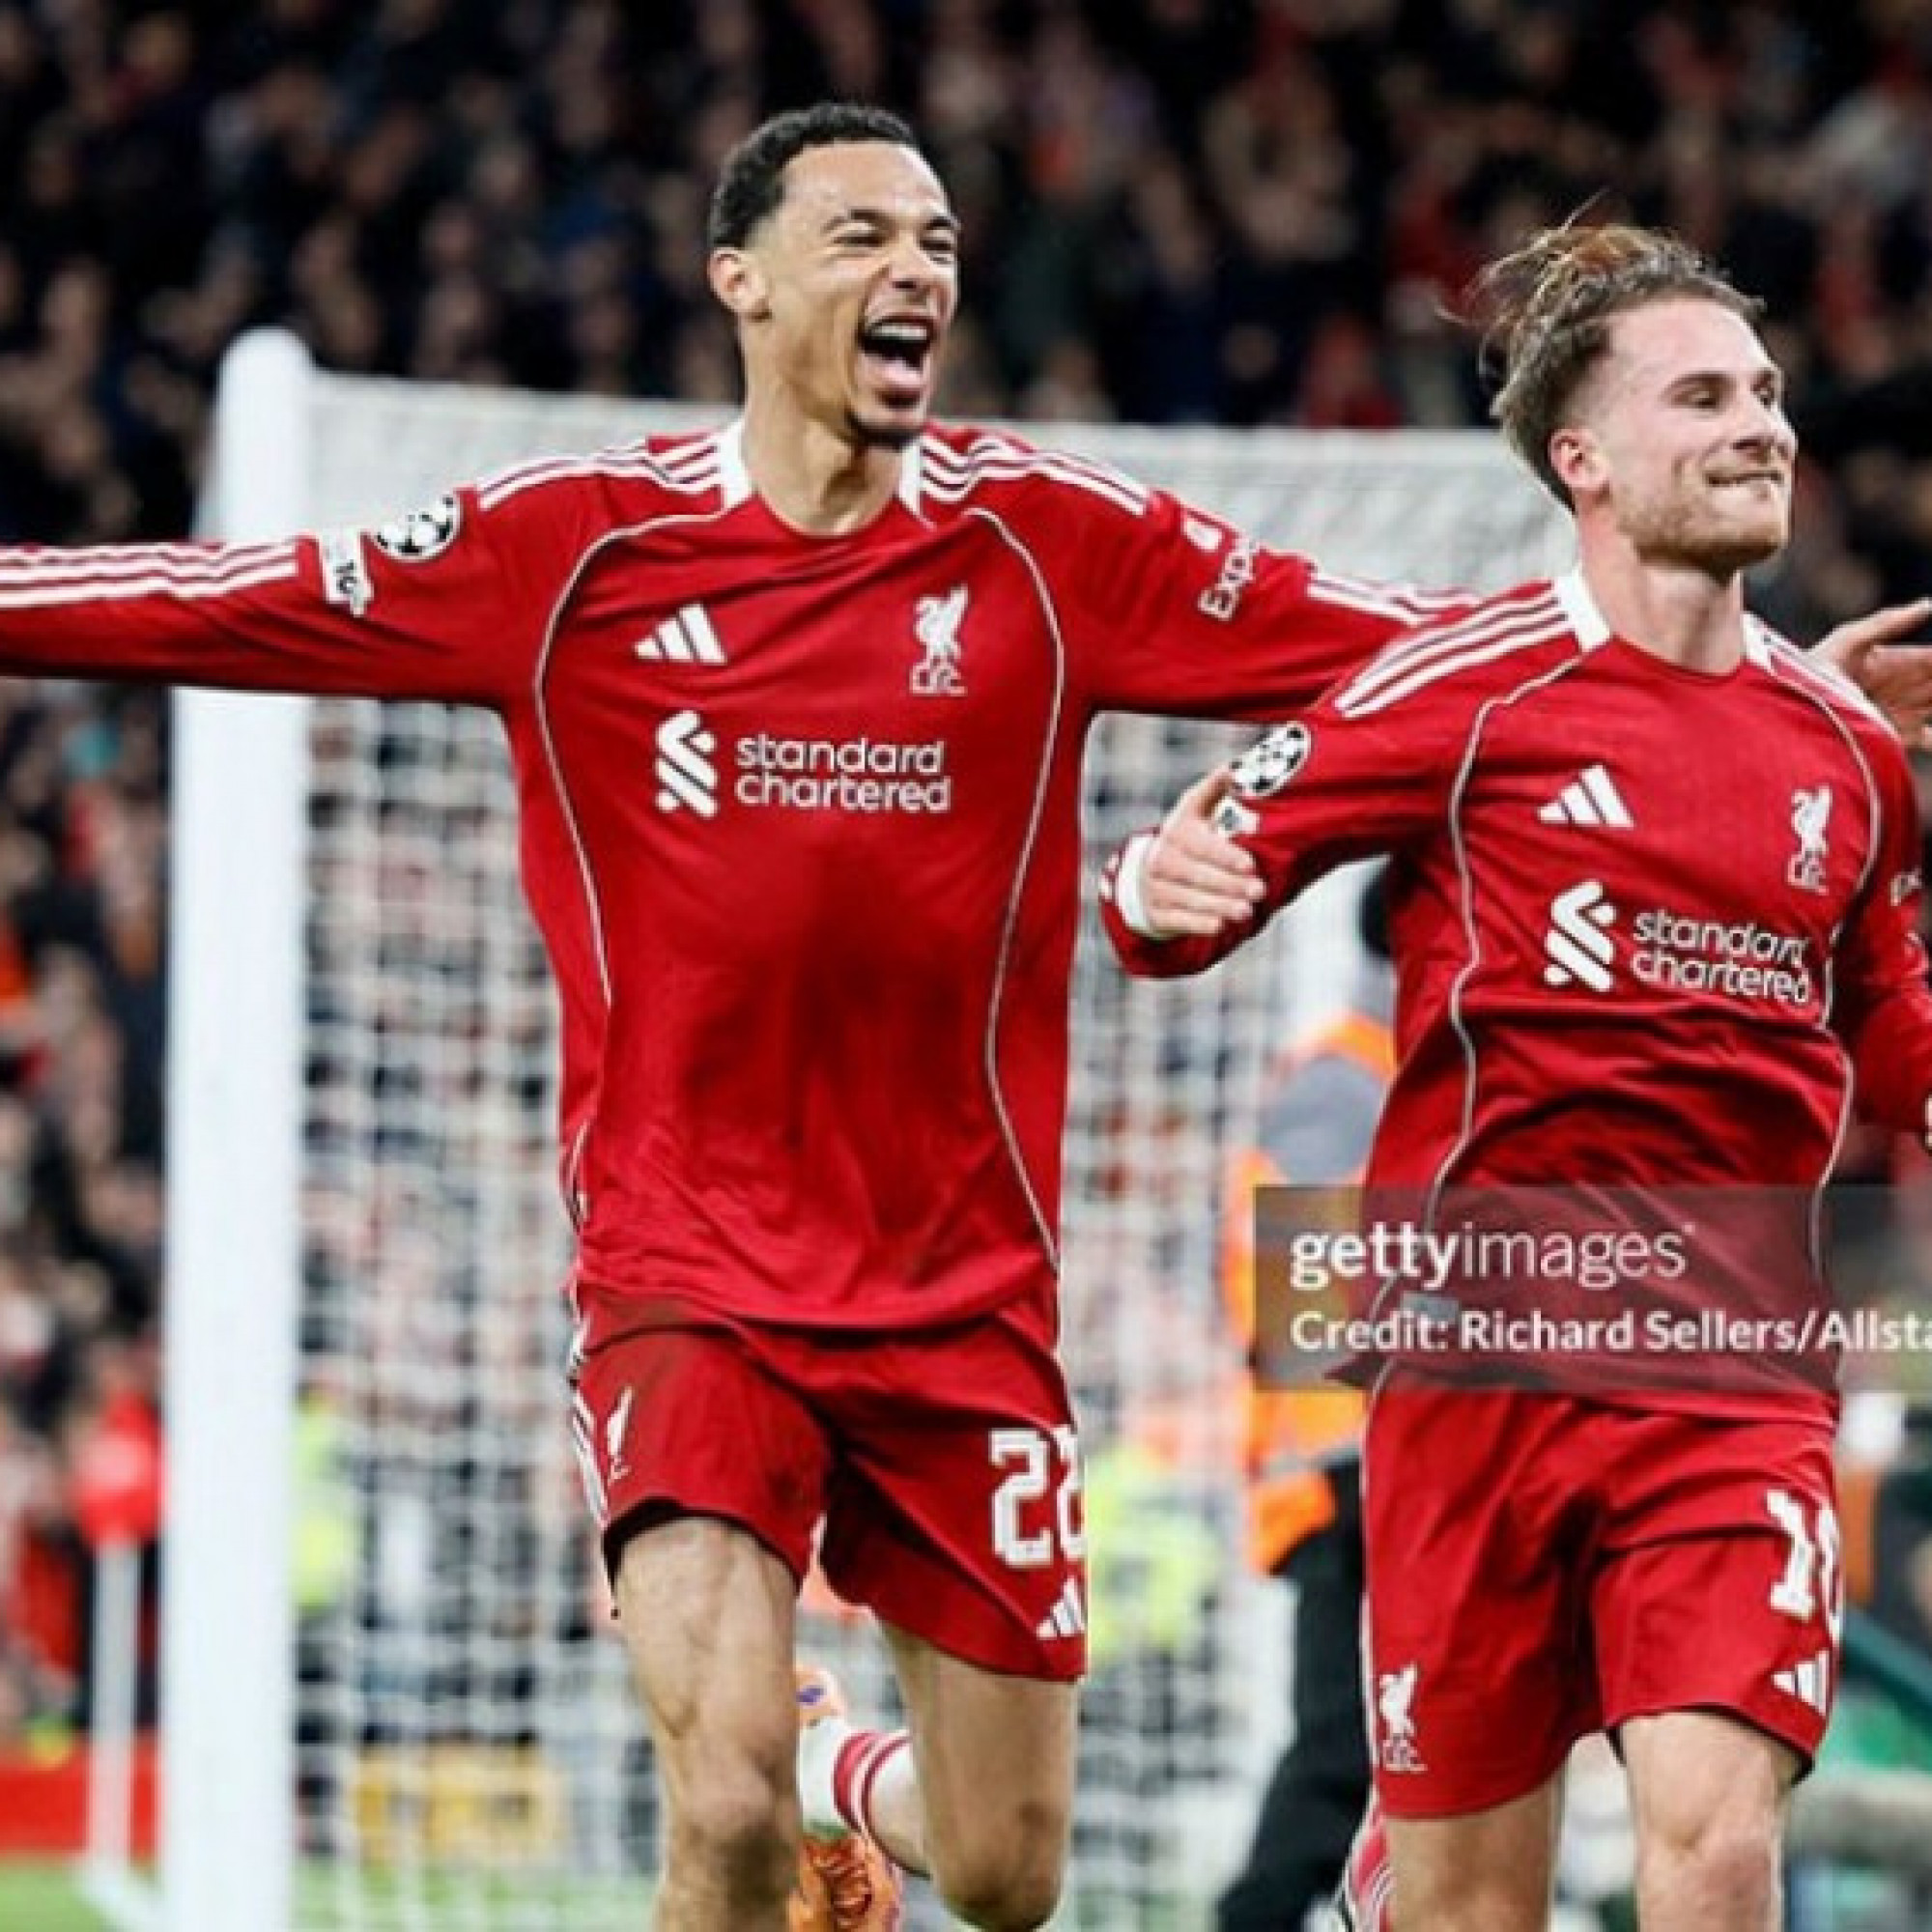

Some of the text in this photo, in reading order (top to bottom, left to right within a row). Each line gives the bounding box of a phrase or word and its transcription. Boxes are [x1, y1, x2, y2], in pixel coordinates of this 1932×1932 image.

[735, 732, 945, 772] standard
[734, 773, 952, 811] chartered
[1631, 949, 1809, 1003] chartered
